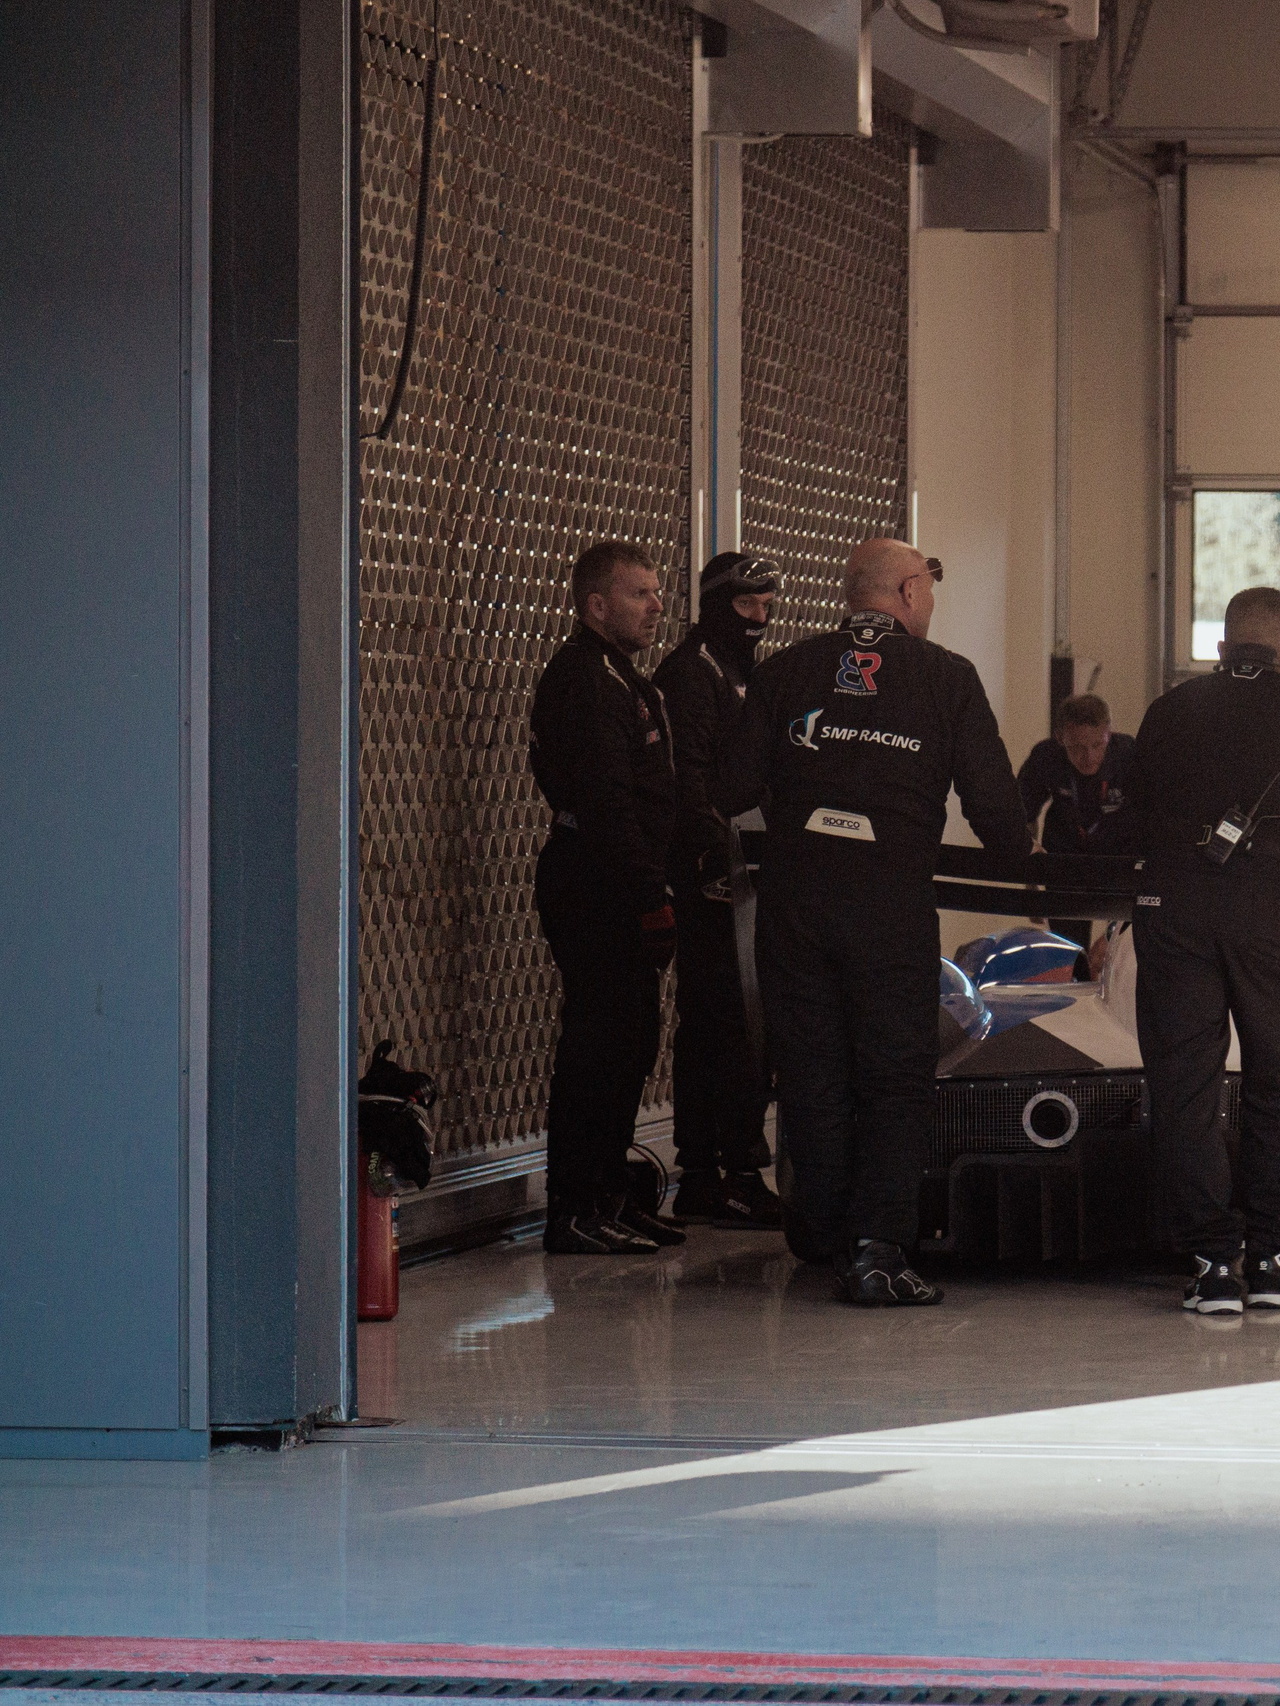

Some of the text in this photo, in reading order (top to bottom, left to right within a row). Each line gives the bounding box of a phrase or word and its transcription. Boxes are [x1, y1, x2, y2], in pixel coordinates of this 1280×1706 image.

[833, 687, 878, 696] ENGINEERING
[820, 726, 922, 752] SMP RACING
[822, 816, 860, 830] sparco
